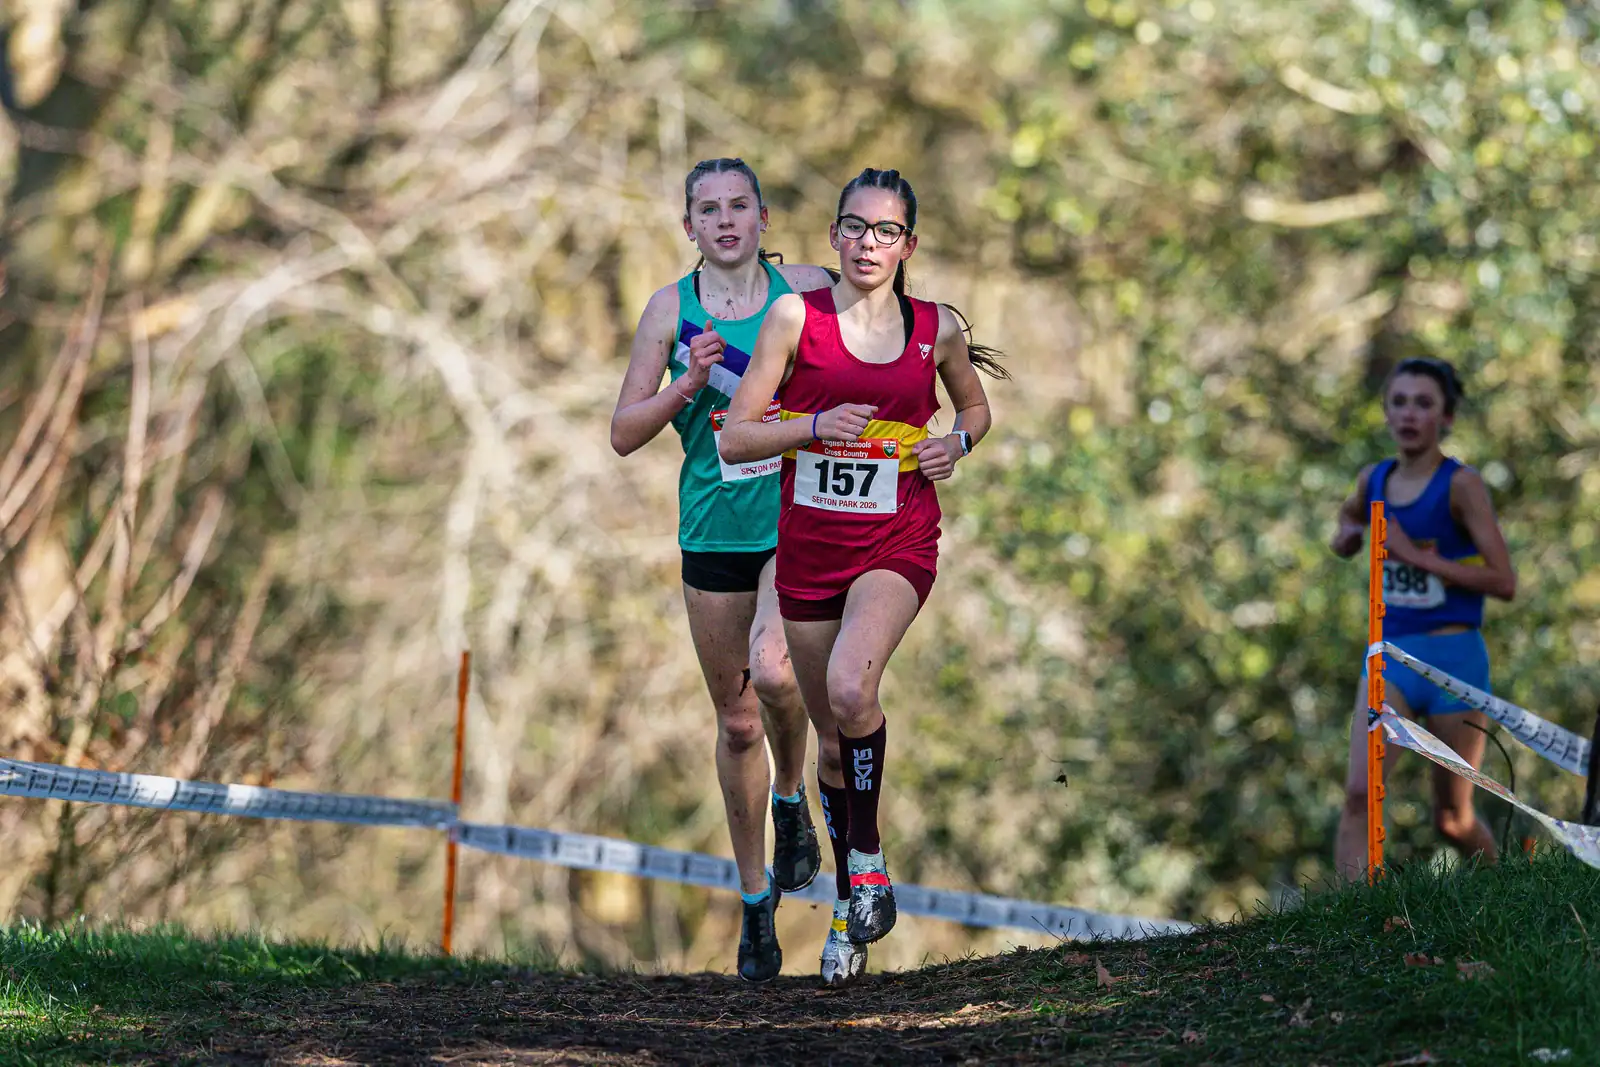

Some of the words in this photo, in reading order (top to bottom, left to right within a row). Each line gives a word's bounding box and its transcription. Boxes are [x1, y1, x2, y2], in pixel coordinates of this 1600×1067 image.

[822, 438, 845, 448] English
[845, 440, 872, 449] Schools
[824, 447, 841, 457] Cross
[842, 449, 869, 459] Country
[814, 459, 879, 497] 157
[812, 495, 837, 507] SEFTON
[838, 500, 858, 509] PARK
[859, 501, 878, 510] 2026
